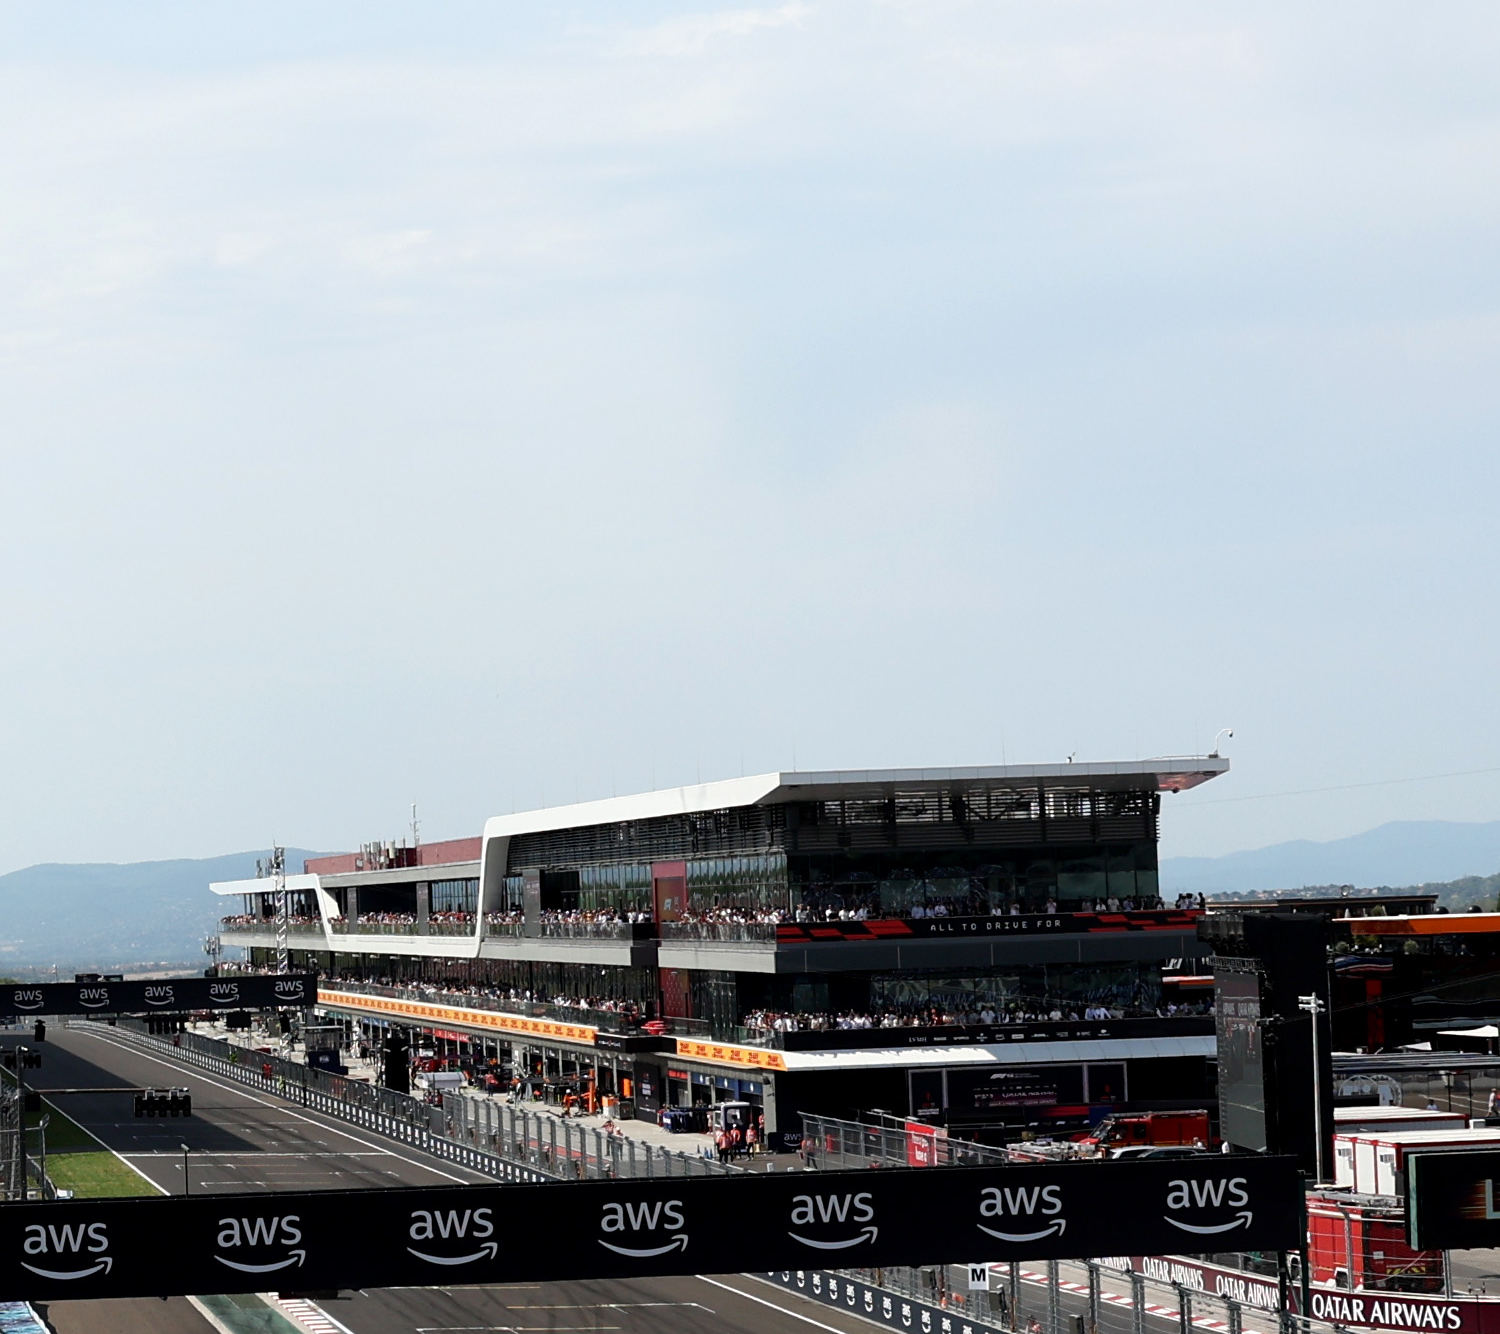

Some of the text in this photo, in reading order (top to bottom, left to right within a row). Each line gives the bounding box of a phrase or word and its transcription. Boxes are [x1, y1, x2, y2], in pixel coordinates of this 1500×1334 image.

[930, 919, 1061, 932] ALL TO DRIVE FOR
[15, 990, 43, 1001] aws
[80, 988, 108, 999] aws
[145, 985, 173, 996] aws
[211, 983, 238, 995] aws
[275, 980, 304, 992] aws
[24, 1178, 1249, 1253] aws aws aws aws aws aws aws
[971, 1268, 986, 1283] M
[1142, 1256, 1171, 1282] QATAR
[1216, 1274, 1290, 1311] QATAR AIRWAS
[1312, 1294, 1461, 1330] QATAR AIRWAYS
